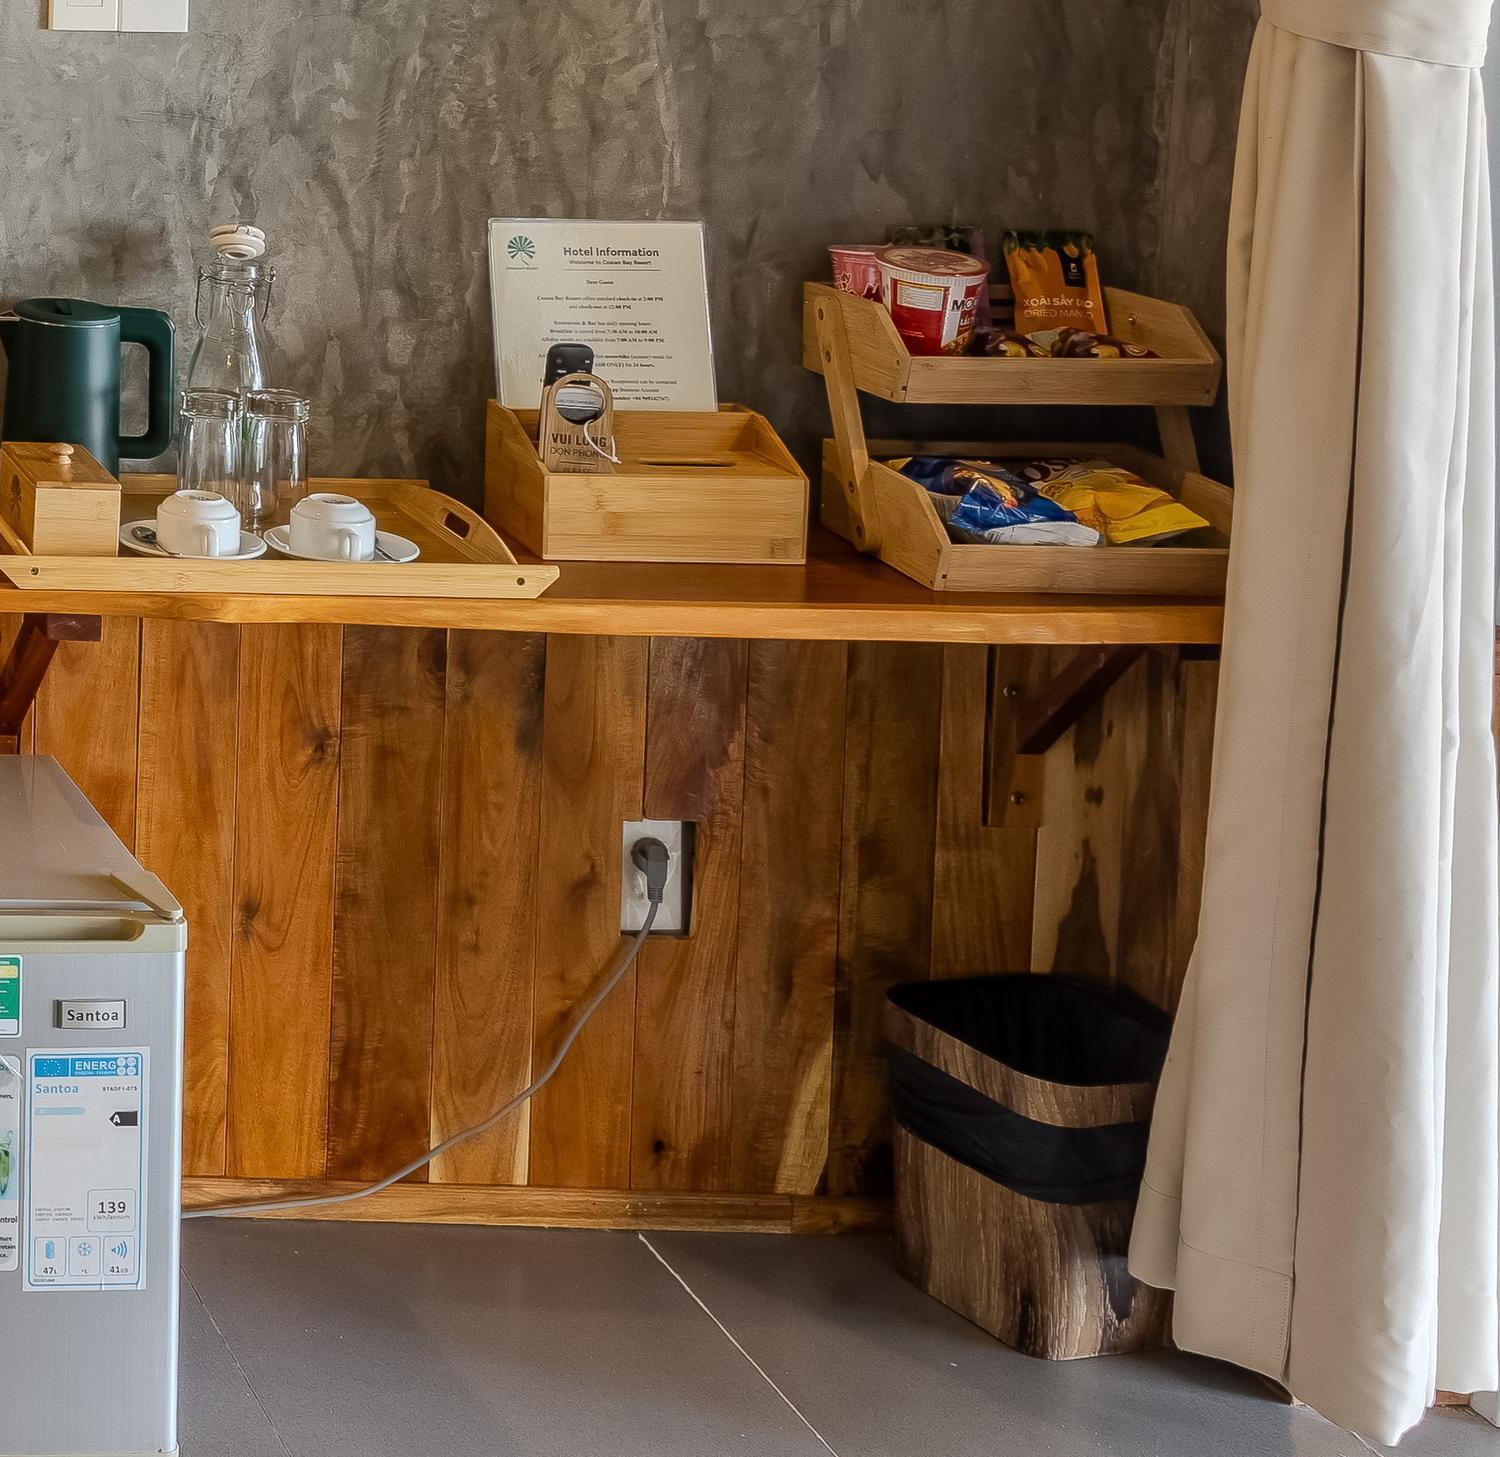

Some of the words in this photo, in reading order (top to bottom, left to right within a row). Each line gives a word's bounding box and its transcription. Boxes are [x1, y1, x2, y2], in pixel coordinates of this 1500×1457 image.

[563, 247, 594, 257] Hotel
[596, 247, 660, 258] Information
[1024, 309, 1057, 318] DRIED
[551, 433, 571, 445] VUI
[67, 1009, 119, 1022] Santoa
[75, 1061, 116, 1070] ENERG
[36, 1084, 79, 1094] Santoa
[113, 1114, 121, 1123] A
[98, 1201, 126, 1214] 139
